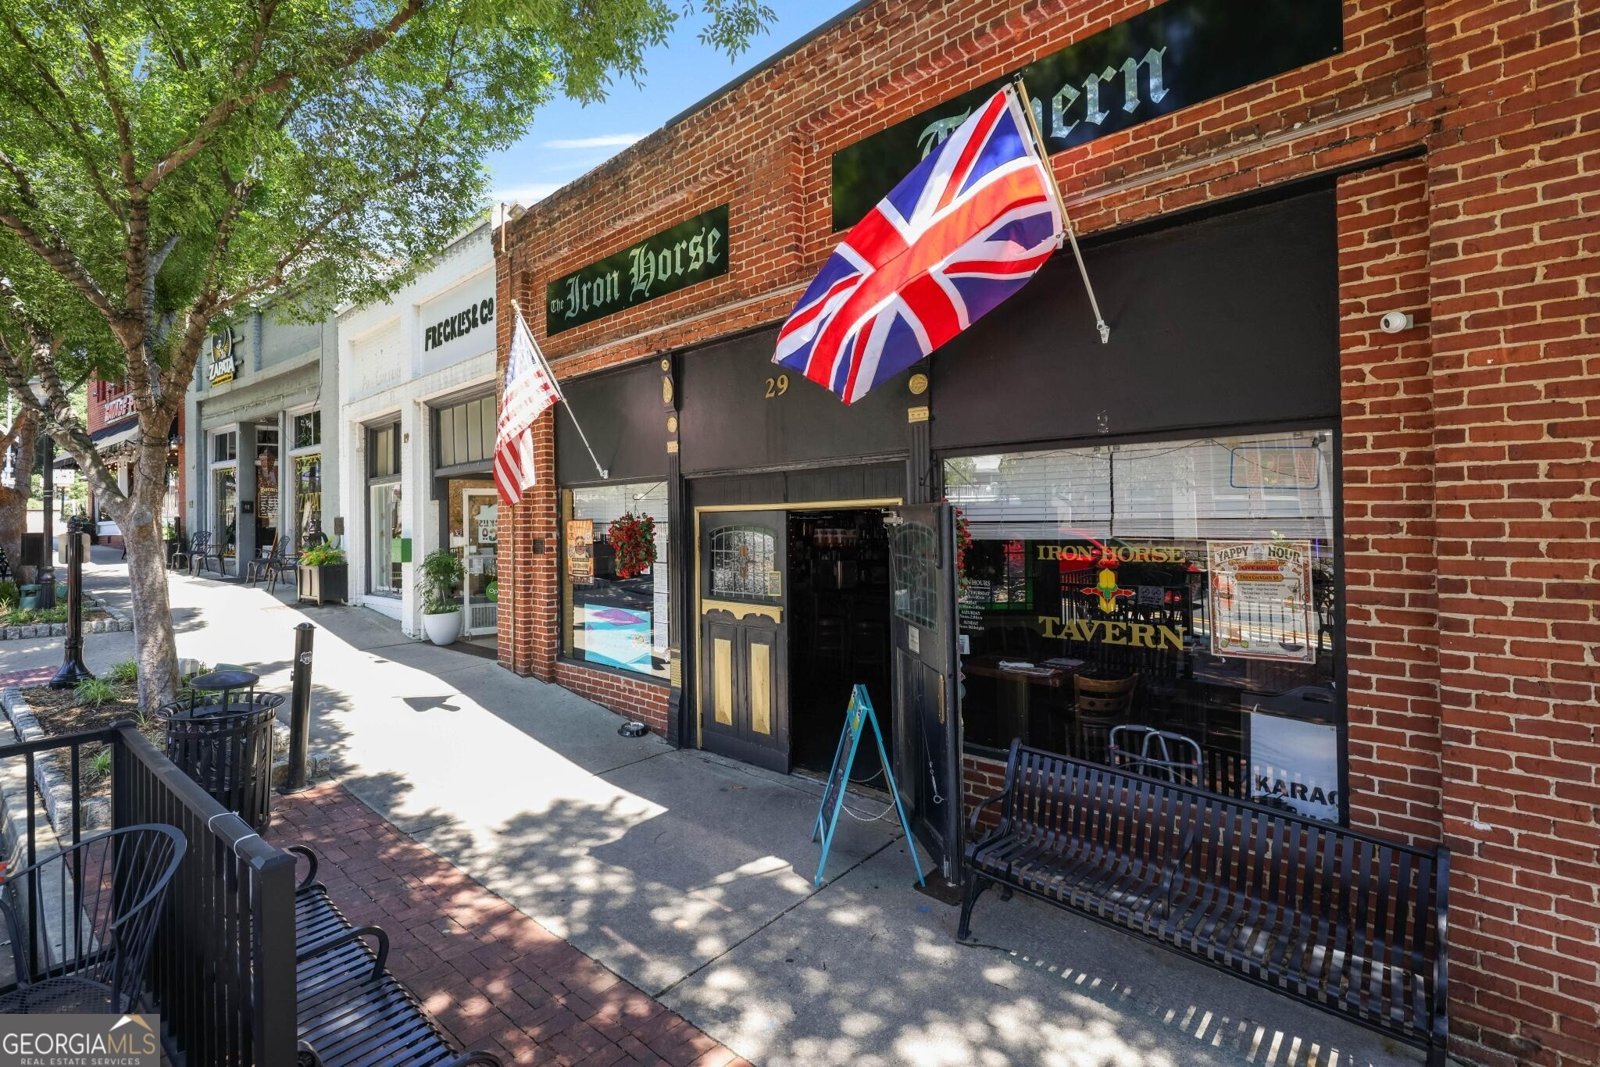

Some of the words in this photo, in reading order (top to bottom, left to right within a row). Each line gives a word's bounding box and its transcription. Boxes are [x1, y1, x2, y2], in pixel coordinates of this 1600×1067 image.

[550, 299, 564, 314] The
[565, 270, 621, 321] Iron
[628, 226, 722, 302] Horse
[209, 355, 236, 381] ZAPATA
[765, 374, 789, 399] 29
[1037, 544, 1093, 561] IRON
[1100, 545, 1186, 564] HORSE
[1217, 546, 1249, 561] YAPPY
[1268, 546, 1301, 563] HOUR
[1038, 616, 1188, 651] TAVERN
